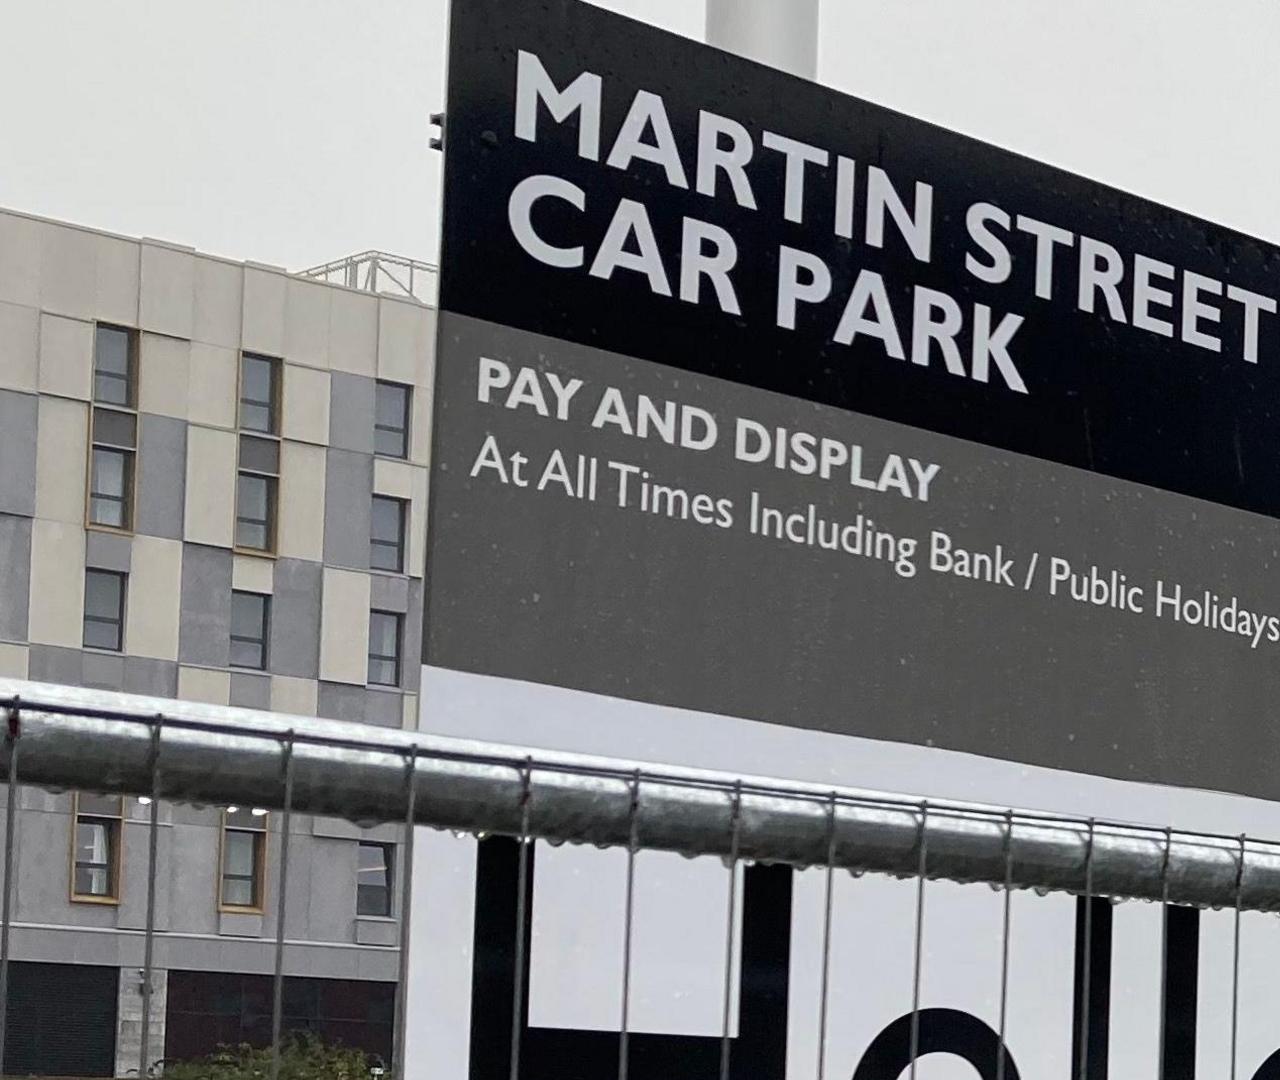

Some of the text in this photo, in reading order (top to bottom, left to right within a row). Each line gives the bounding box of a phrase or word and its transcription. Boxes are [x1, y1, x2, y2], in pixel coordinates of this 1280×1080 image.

[508, 174, 1029, 394] CAR PARK
[514, 49, 1278, 364] MARTIN STREET
[477, 357, 940, 502] PAY AND DISPLAY
[471, 435, 1280, 649] At All Times Including Bank / Public Holidays
